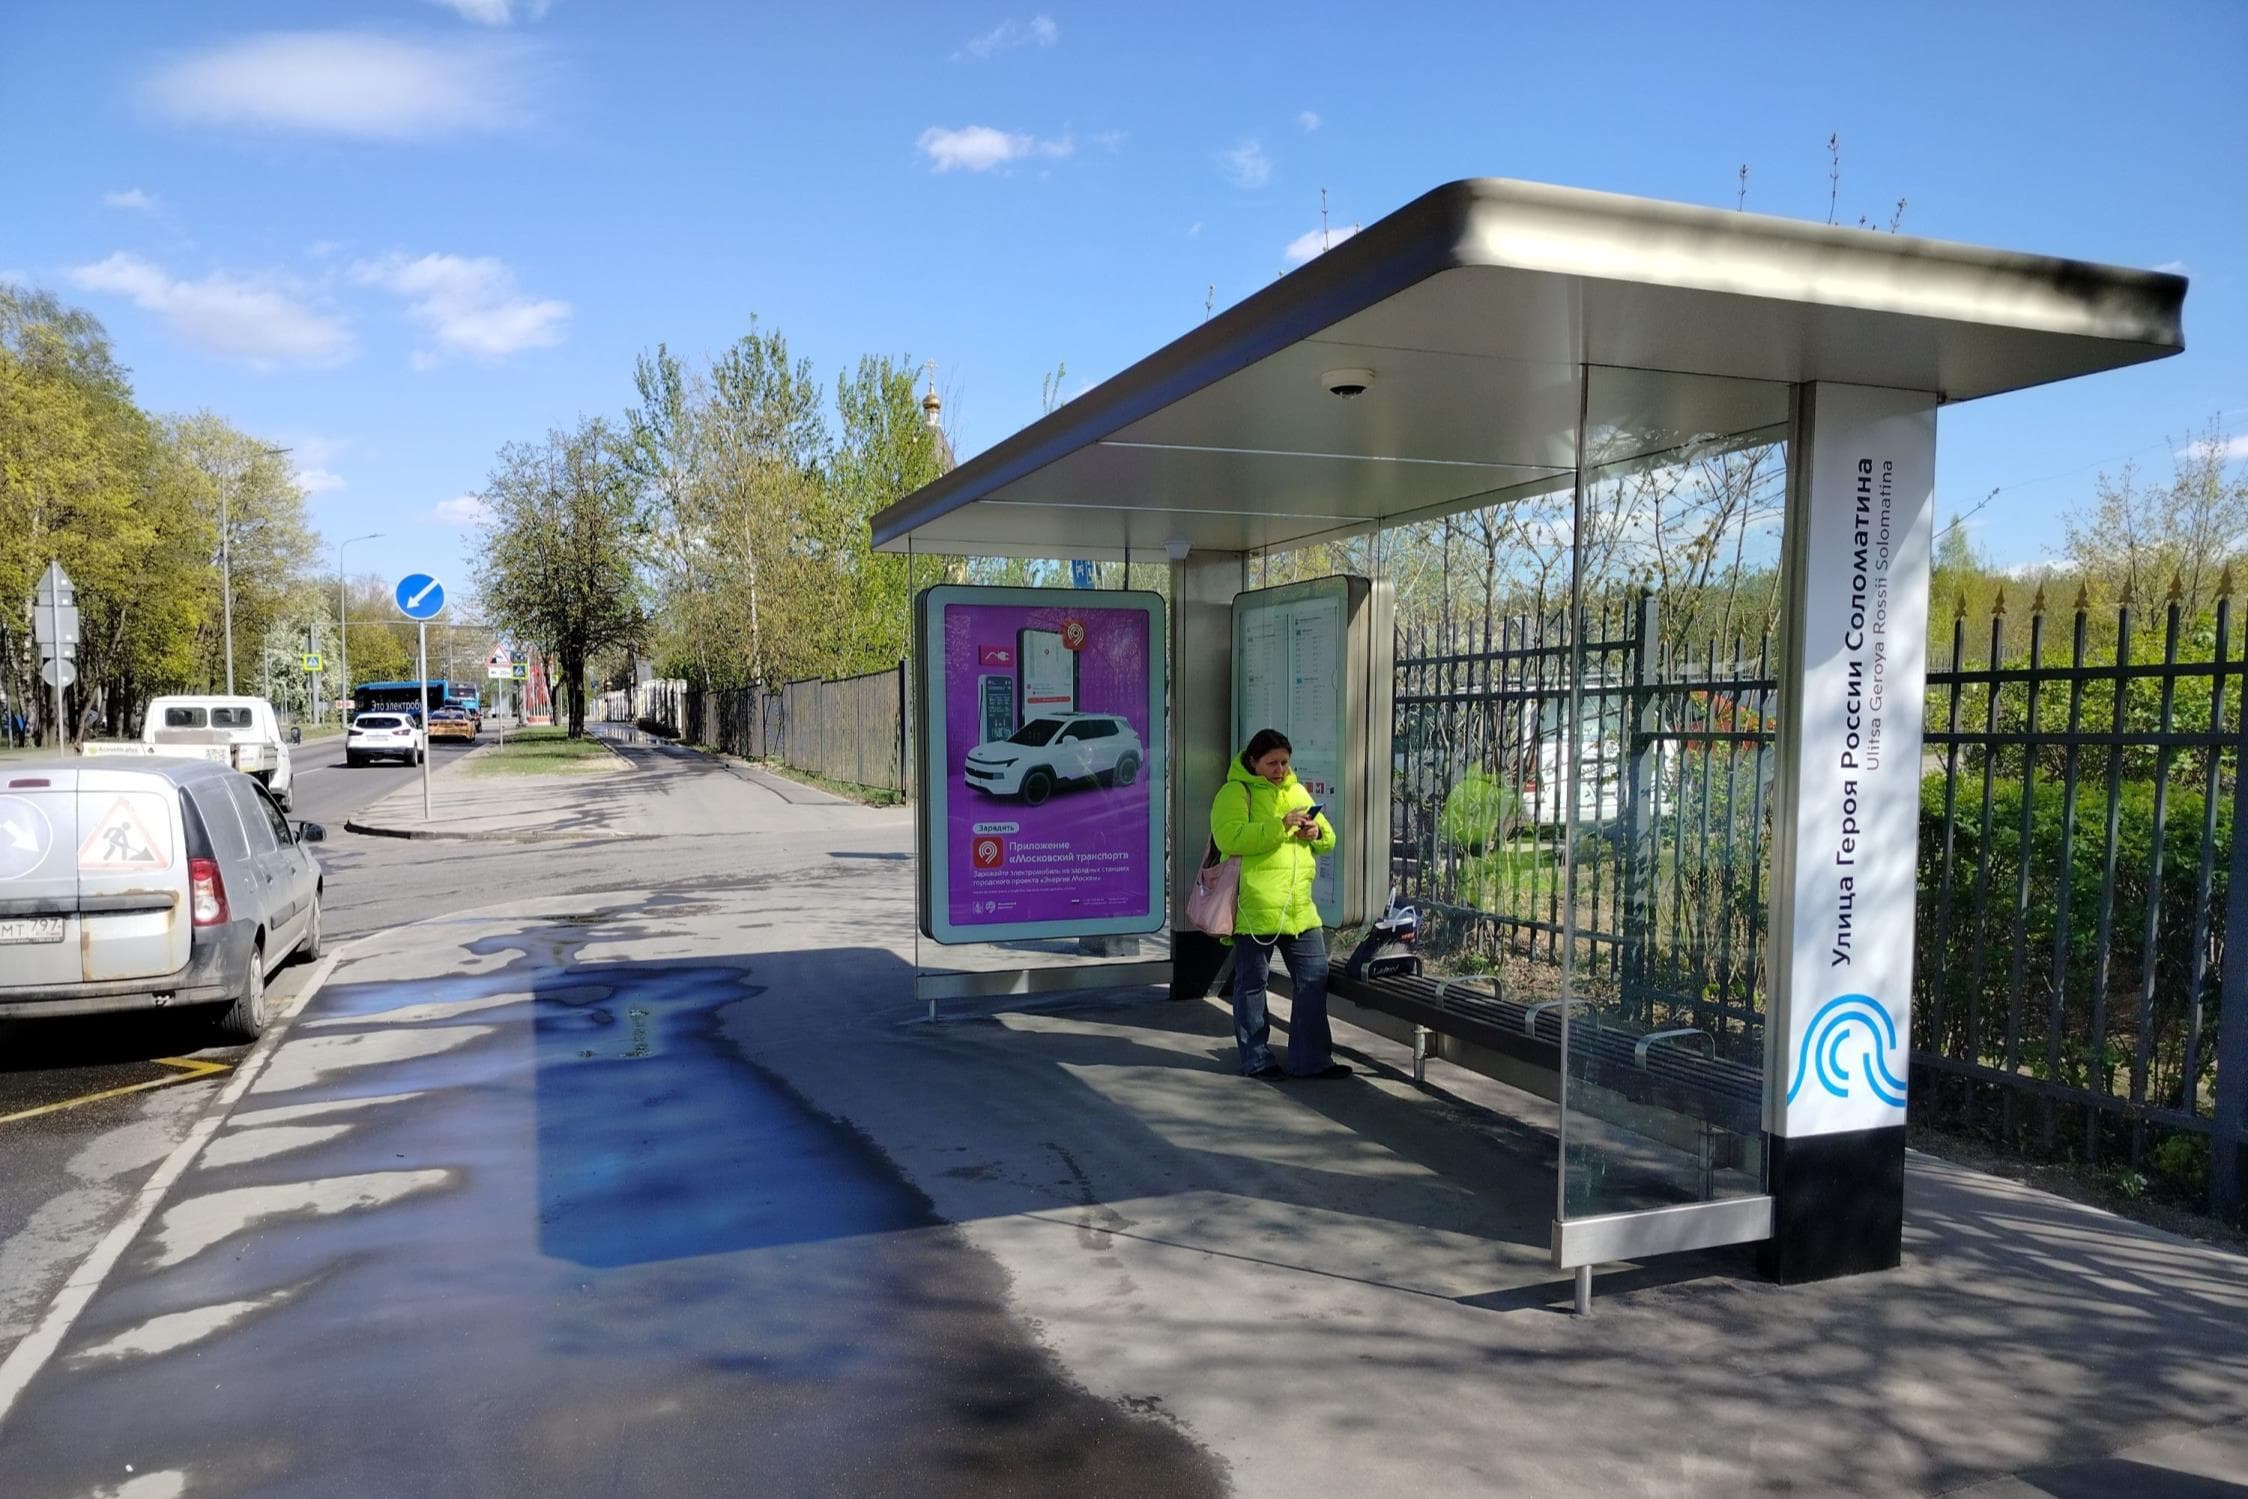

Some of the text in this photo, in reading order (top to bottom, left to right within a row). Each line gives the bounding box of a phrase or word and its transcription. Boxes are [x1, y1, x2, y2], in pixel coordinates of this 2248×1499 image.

[1867, 460, 1893, 771] Ulitsa Geroya Rossii Solomatina
[371, 698, 422, 712] Это электробу
[1832, 458, 1873, 967] Улица Героя России Соломатина
[979, 824, 1015, 832] Зарядить
[1009, 841, 1070, 852] Приложение
[1009, 852, 1074, 863] «Московский
[31, 919, 58, 932] 797
